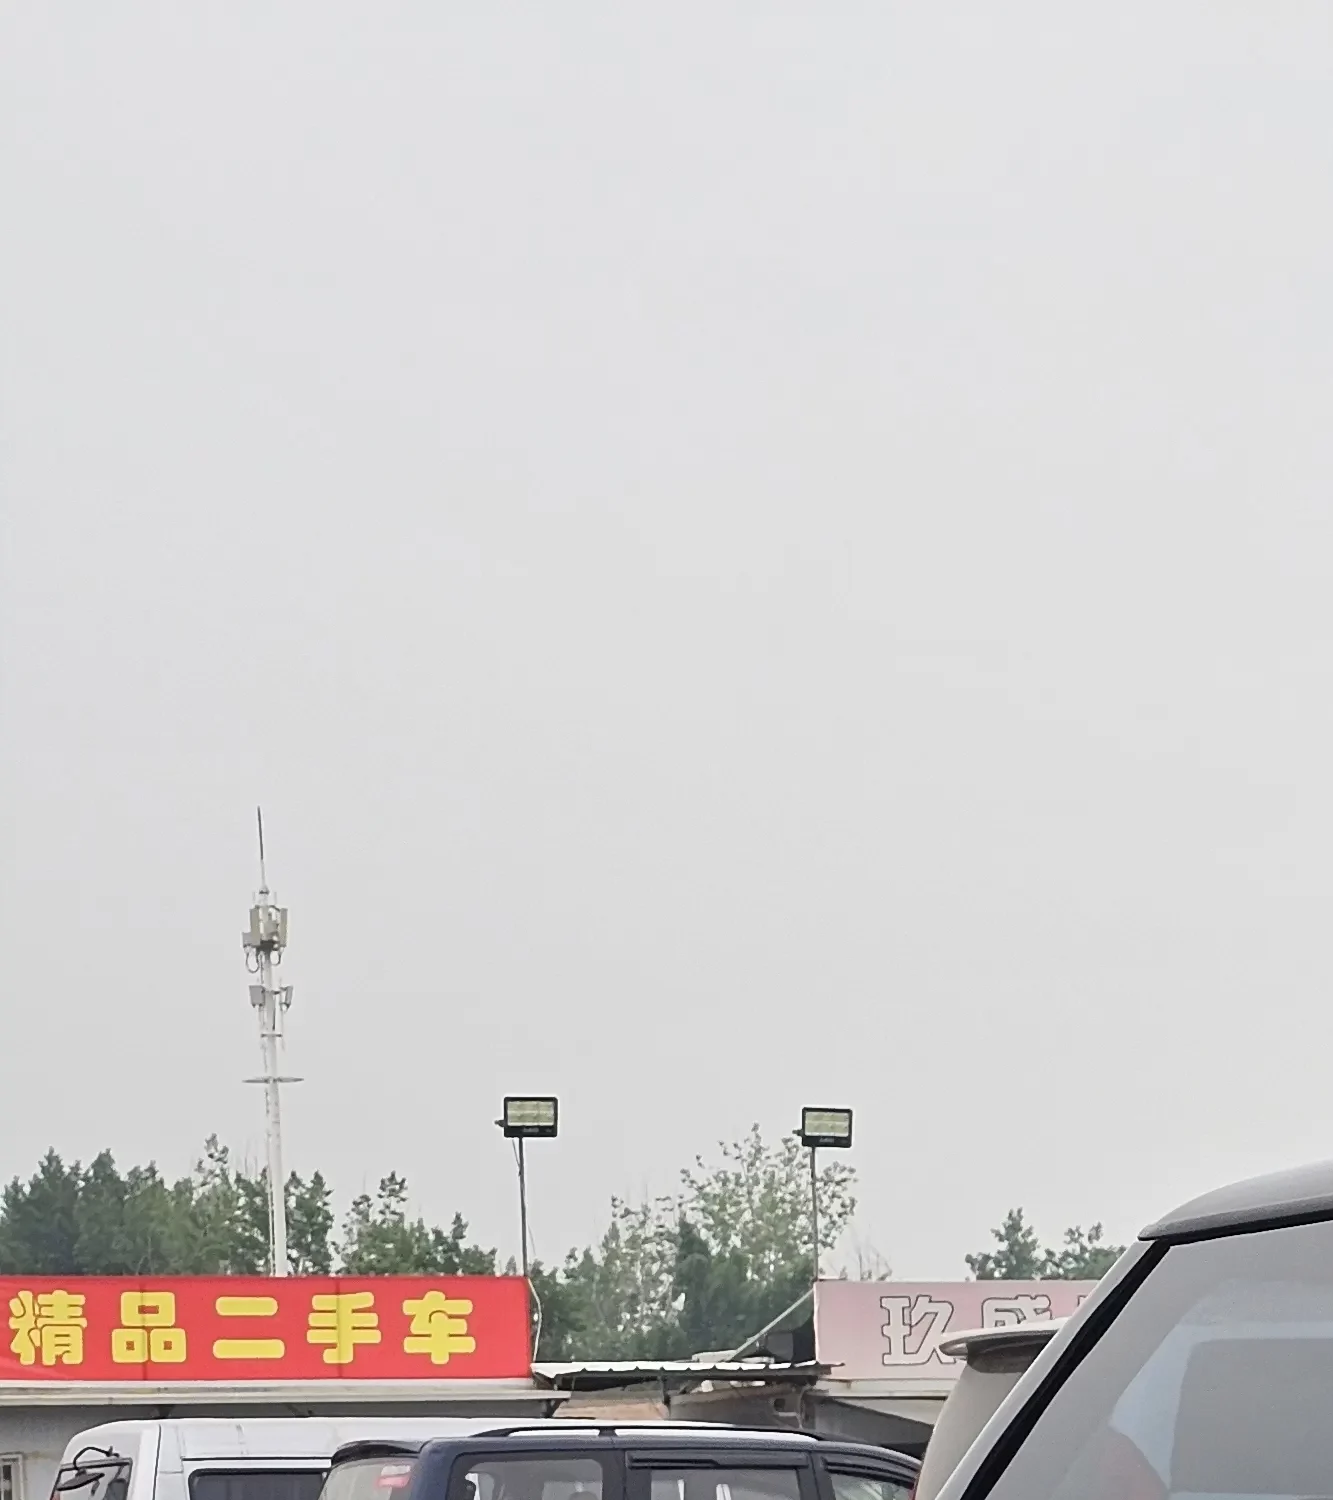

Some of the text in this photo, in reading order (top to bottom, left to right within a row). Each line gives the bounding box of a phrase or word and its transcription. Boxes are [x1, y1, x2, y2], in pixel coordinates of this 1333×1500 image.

[8, 1289, 477, 1366] 精品二手车
